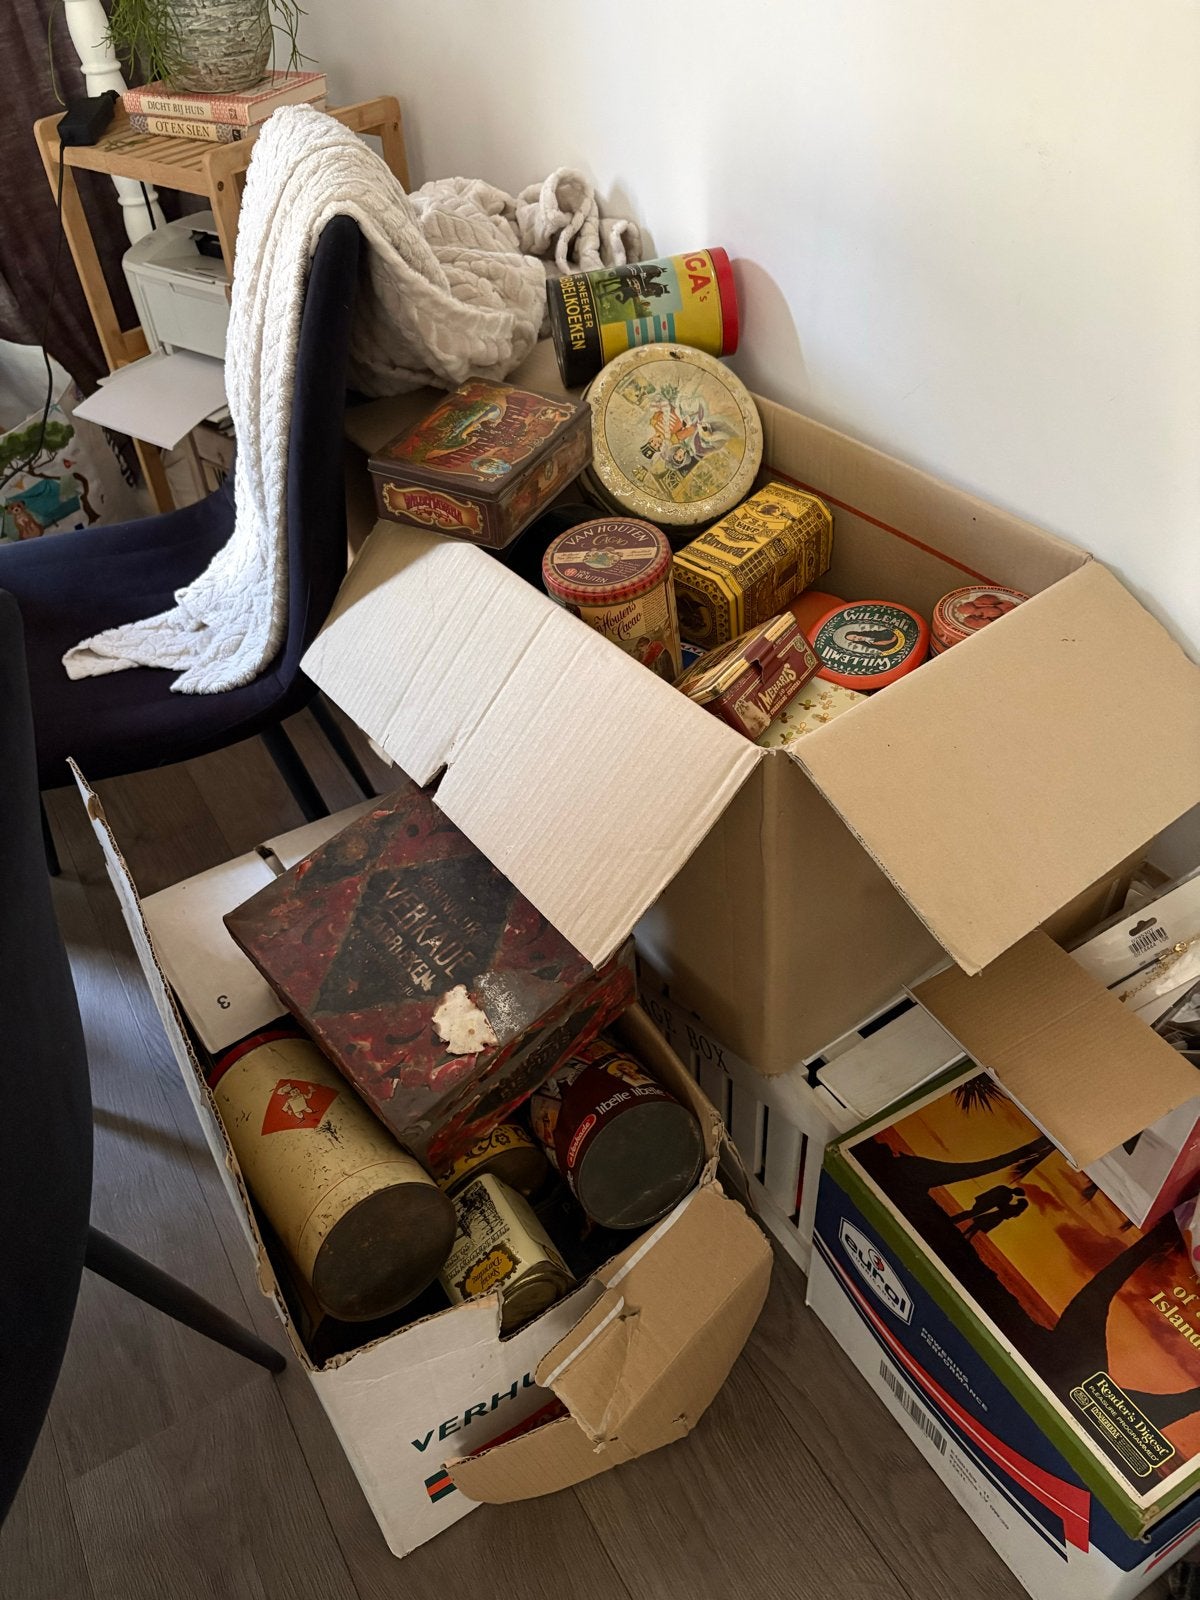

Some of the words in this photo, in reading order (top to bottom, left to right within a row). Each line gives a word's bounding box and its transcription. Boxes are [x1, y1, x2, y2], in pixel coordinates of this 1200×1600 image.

[147, 100, 171, 112] DICHT
[173, 103, 184, 115] BIJ
[186, 105, 205, 116] HUIS
[155, 121, 171, 133] OT
[171, 123, 186, 135] EN
[186, 124, 210, 137] SIEN
[577, 281, 593, 328] SNEEKER
[565, 528, 593, 546] VAN
[598, 524, 649, 542] HOUTEN
[574, 572, 609, 583] HOUTEN
[612, 613, 642, 641] Cacao
[383, 876, 477, 978] VERKADE
[685, 1024, 729, 1073] BOX
[595, 1092, 631, 1115] libelle
[845, 1233, 906, 1313] eurol
[1173, 1286, 1199, 1305] of
[920, 1330, 988, 1412] PERFORMANCE
[922, 1327, 970, 1383] POWERING
[1088, 1385, 1118, 1418] PLEASURE
[1116, 1416, 1158, 1461] PROGRAMMED
[1097, 1378, 1136, 1423] Reader's
[1134, 1421, 1166, 1456] Digest
